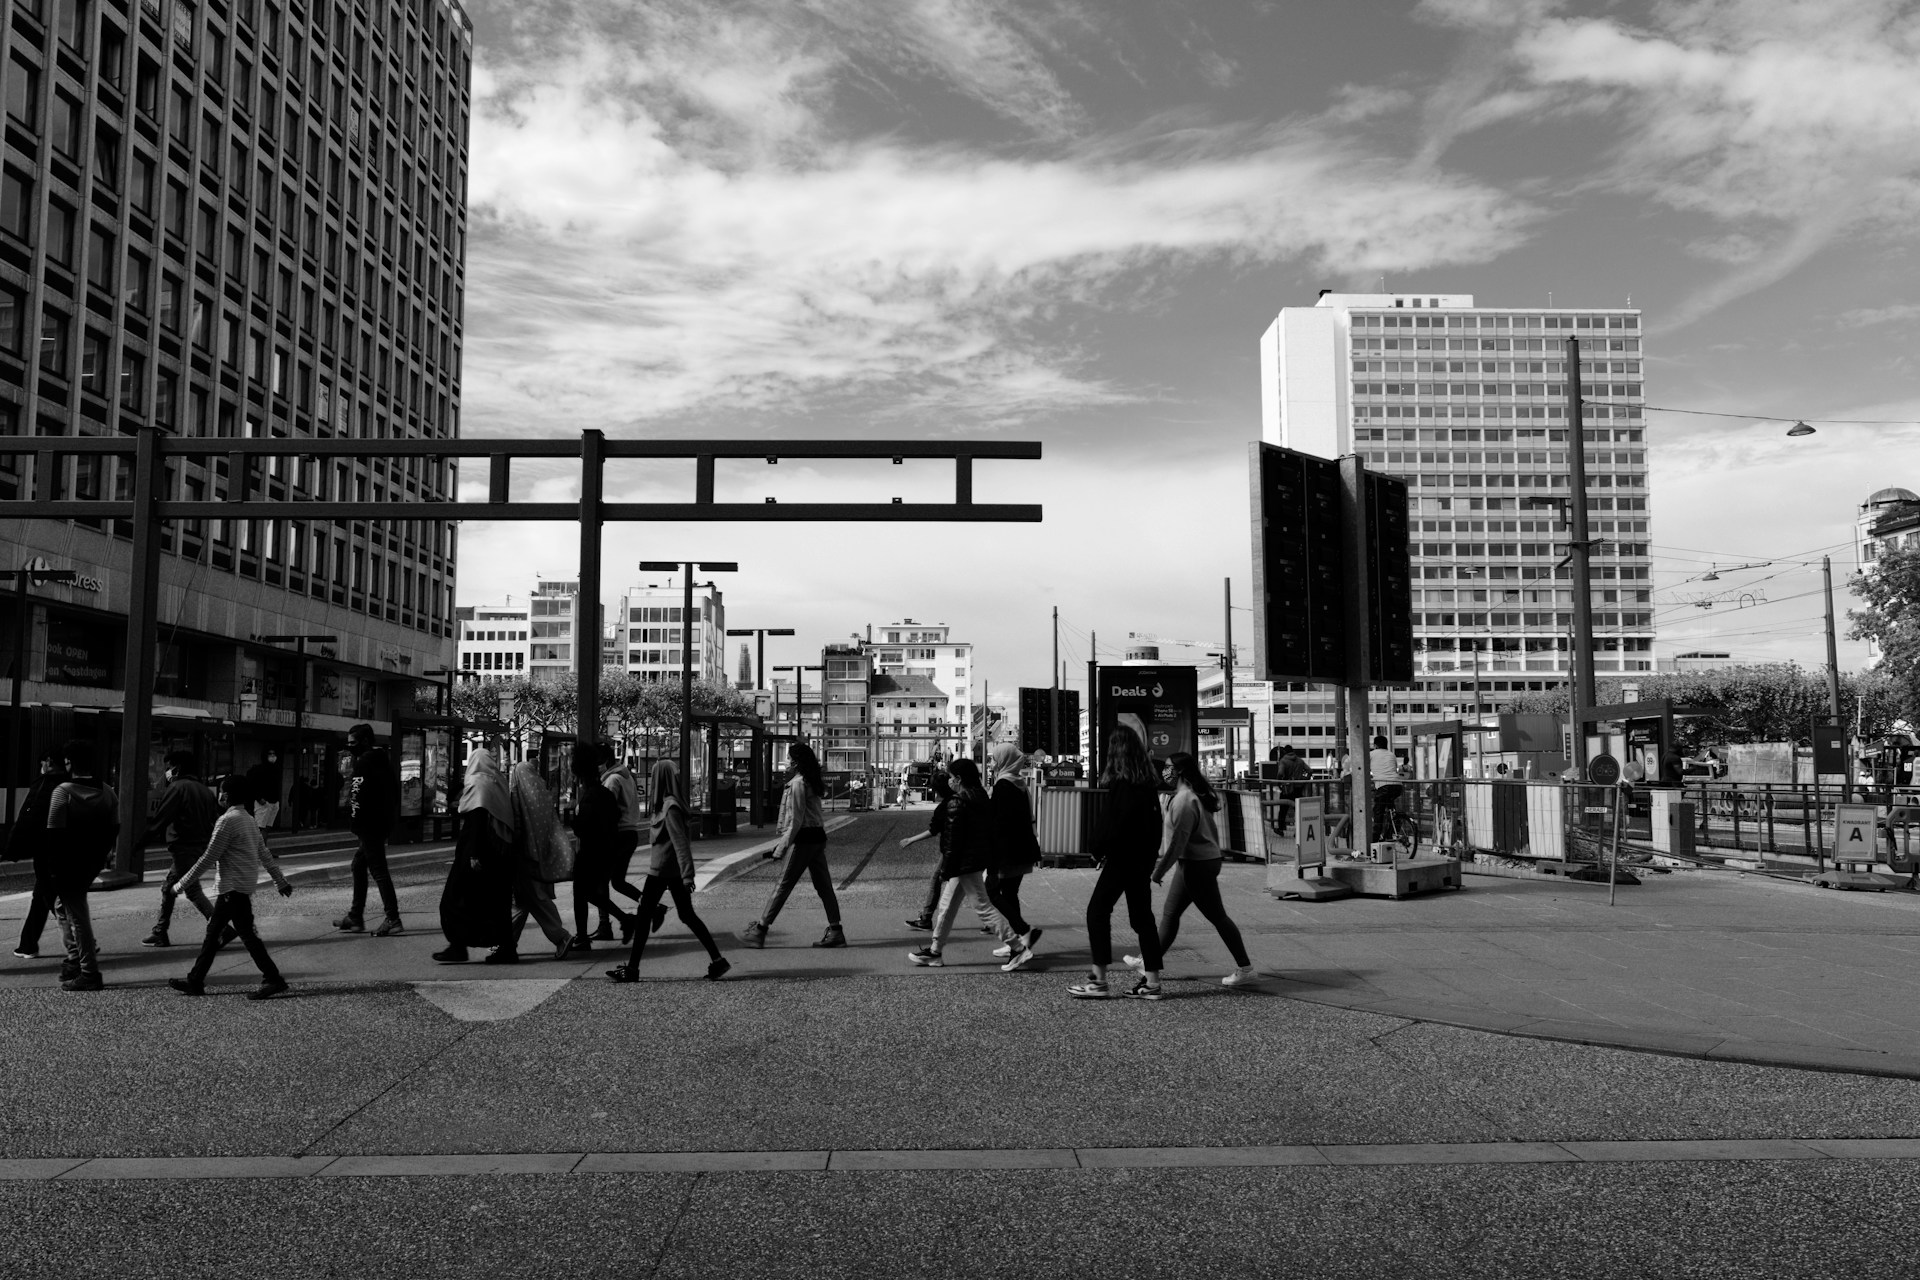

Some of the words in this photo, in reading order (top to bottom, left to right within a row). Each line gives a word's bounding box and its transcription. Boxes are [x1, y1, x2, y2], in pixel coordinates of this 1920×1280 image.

[47, 643, 63, 655] ook
[66, 646, 88, 661] OPEN
[48, 667, 60, 676] en
[1112, 686, 1147, 697] Deals
[1059, 769, 1075, 777] bam
[1306, 824, 1315, 842] A
[1849, 827, 1863, 842] A
